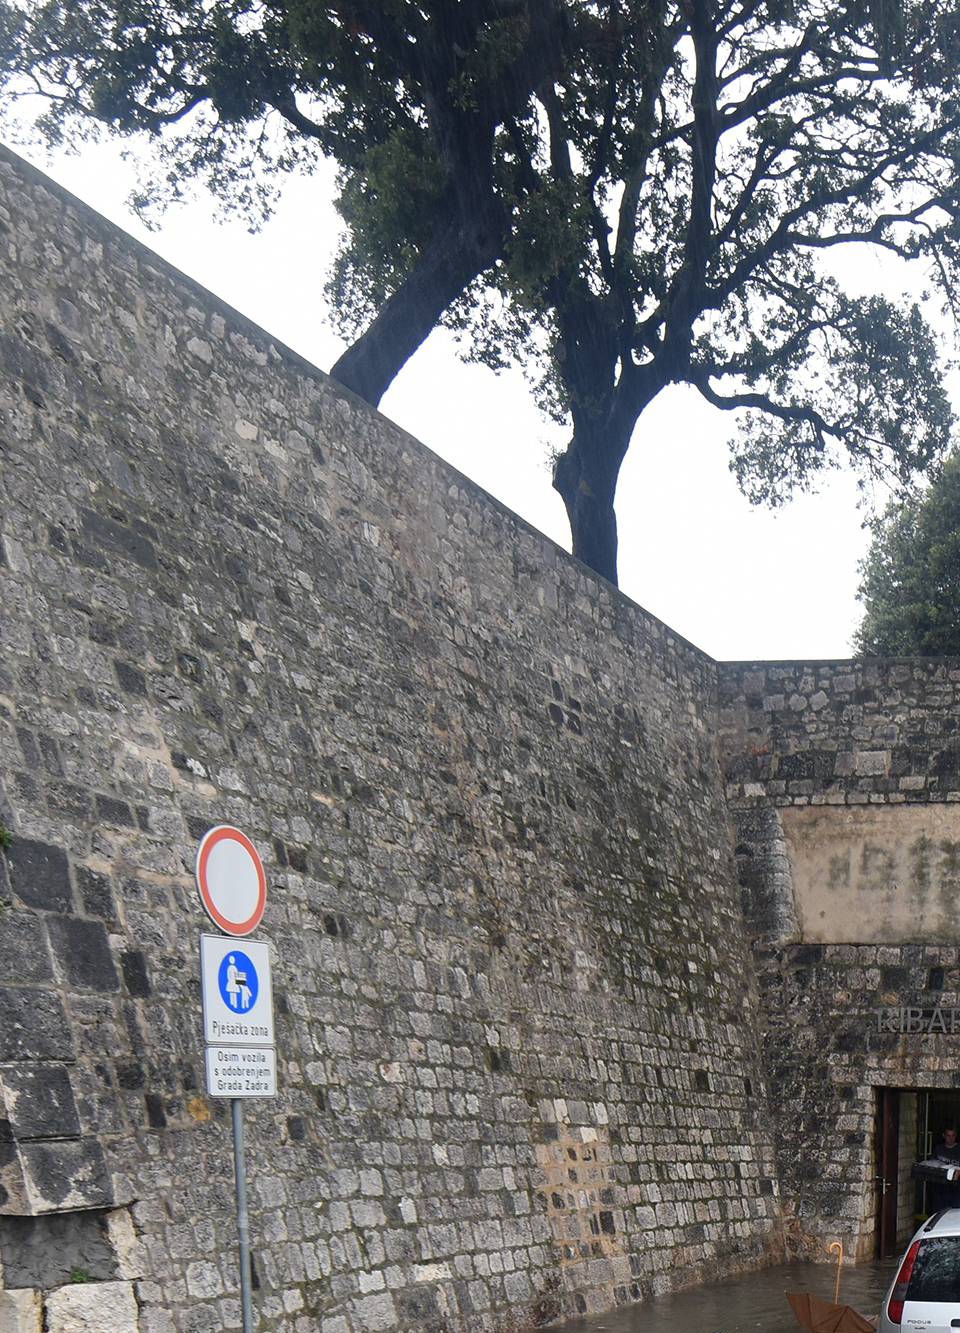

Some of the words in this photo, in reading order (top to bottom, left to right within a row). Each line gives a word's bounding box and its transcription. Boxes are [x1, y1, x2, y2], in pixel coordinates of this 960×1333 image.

[250, 1025, 268, 1037] zona
[217, 1050, 239, 1062] Osim
[241, 1052, 266, 1063] vozila
[214, 1067, 219, 1076] s
[222, 1066, 271, 1079] odobrenjem
[217, 1079, 242, 1091] Grada
[245, 1079, 269, 1091] Zadra
